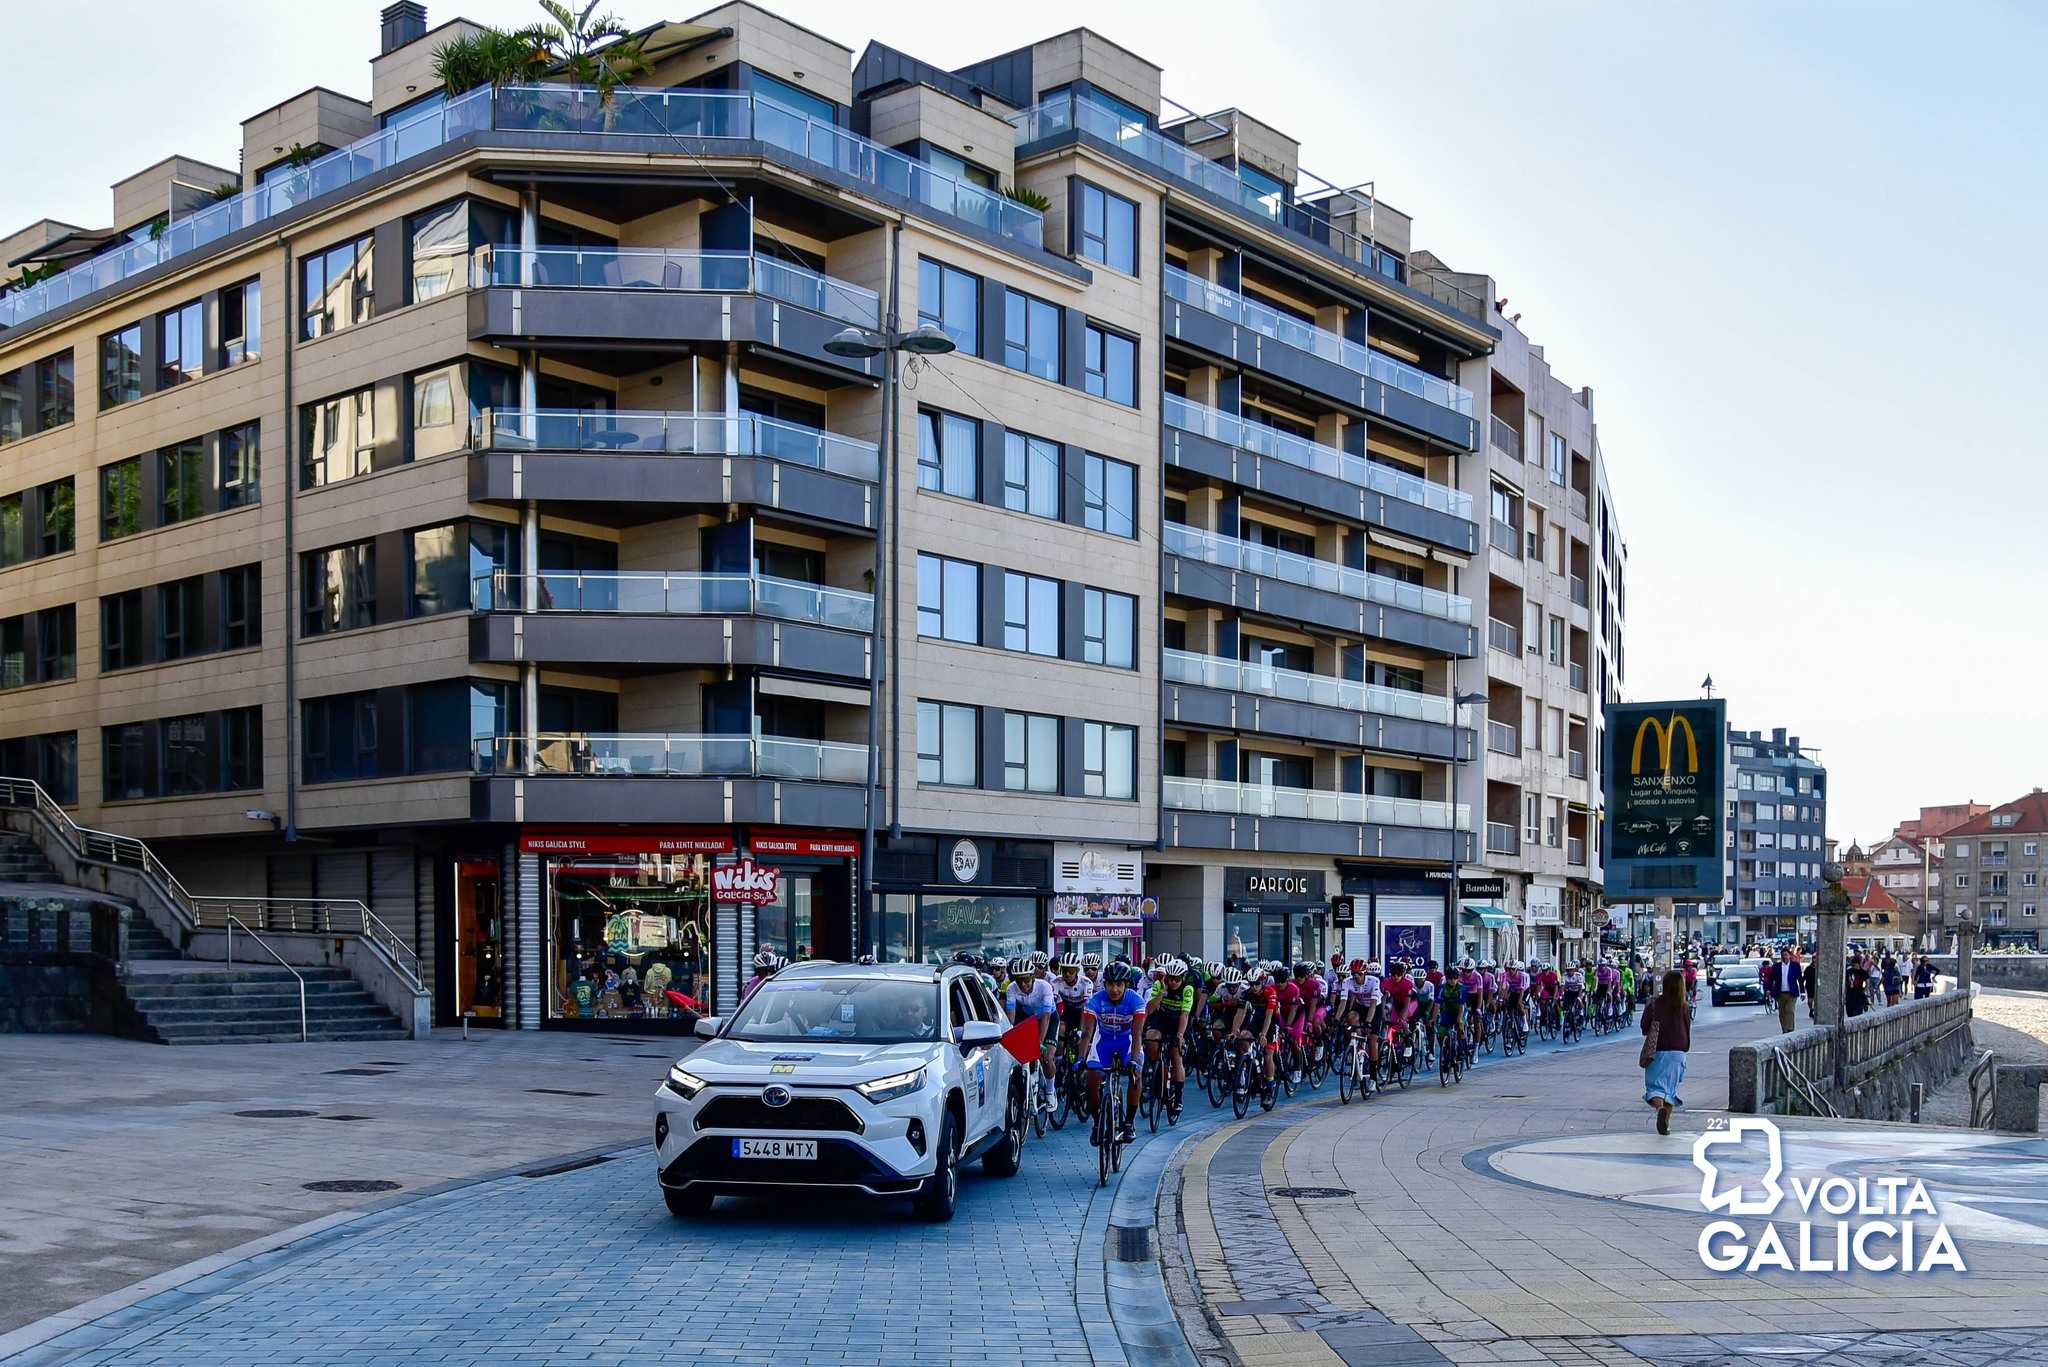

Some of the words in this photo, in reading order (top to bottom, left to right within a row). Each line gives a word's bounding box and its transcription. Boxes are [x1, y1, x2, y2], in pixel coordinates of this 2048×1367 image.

[1633, 775, 1696, 787] SANXENXO
[1630, 789, 1651, 798] Lugar
[1653, 788, 1663, 796] de
[1633, 798, 1660, 806] acceso
[528, 840, 545, 849] NIKIS
[545, 840, 568, 849] GALICIA
[568, 840, 587, 849] STYLE
[659, 841, 675, 849] PARA
[676, 841, 694, 849] XENTE
[694, 841, 725, 849] NIKELADA!
[785, 842, 797, 851] STYLE
[810, 843, 821, 851] PARA
[714, 861, 775, 891] Nikis
[1250, 876, 1307, 893] PARFOIS
[1066, 927, 1097, 937] GOFRERÍA
[1100, 927, 1132, 937] HELADERÍA
[743, 1141, 781, 1157] 5448
[785, 1143, 814, 1158] MTX
